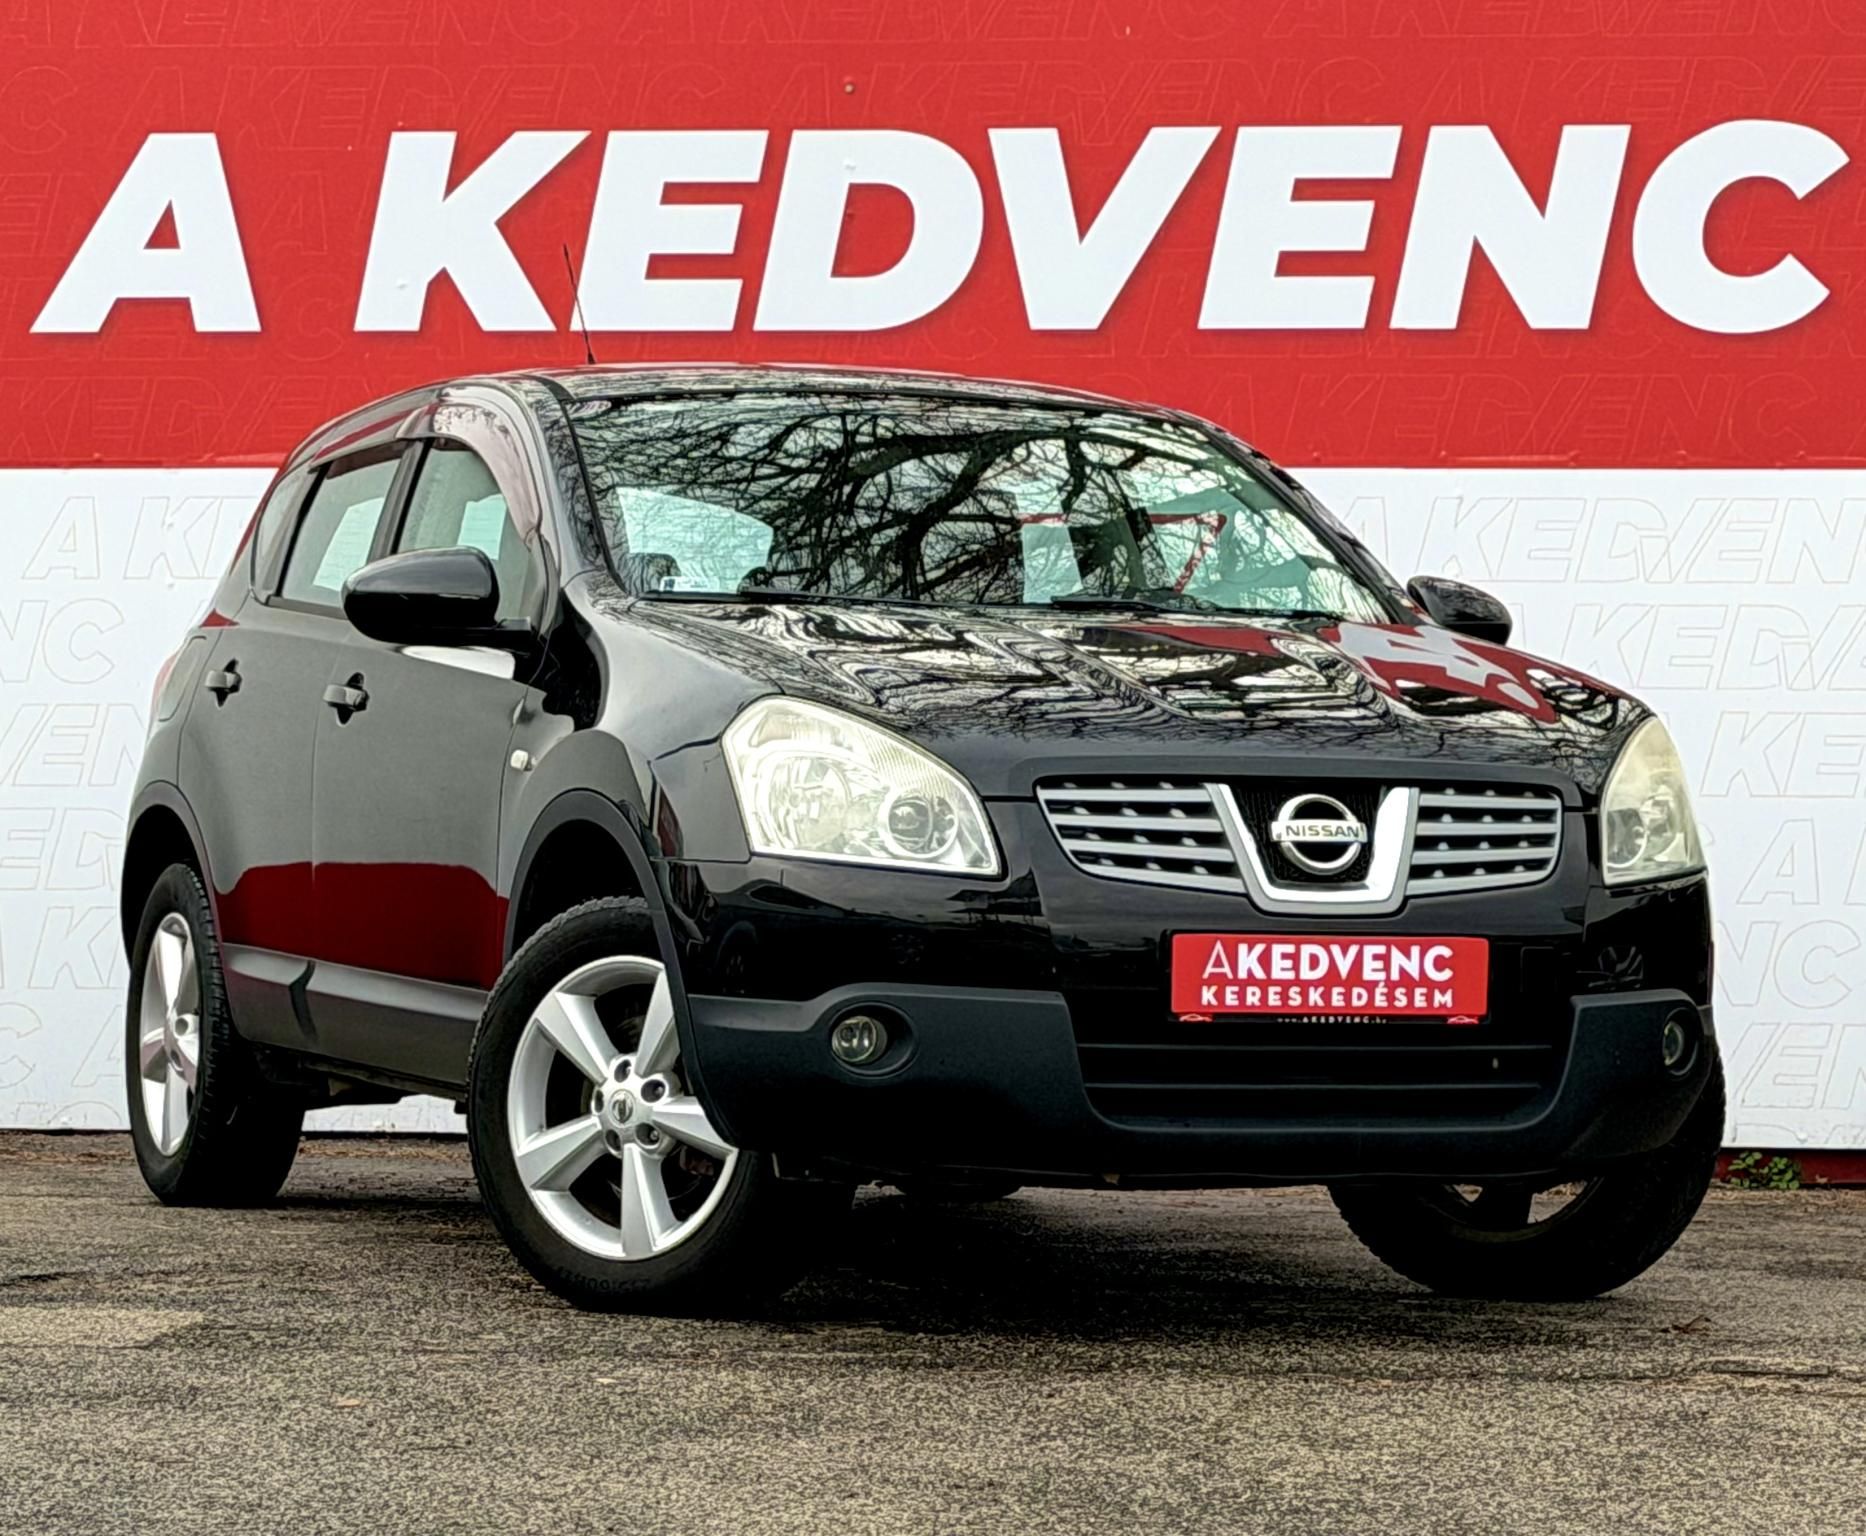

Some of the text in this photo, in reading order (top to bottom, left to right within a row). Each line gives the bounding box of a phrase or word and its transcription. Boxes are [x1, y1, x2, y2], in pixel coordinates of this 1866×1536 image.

[29, 131, 262, 333] A
[353, 119, 1850, 335] KEDVENC
[21, 496, 101, 580] A
[1413, 496, 1866, 584] KEDVEN
[1285, 825, 1360, 838] NISSAN
[1736, 817, 1820, 906] A
[1201, 982, 1454, 1008] KERESKEDÉSEM
